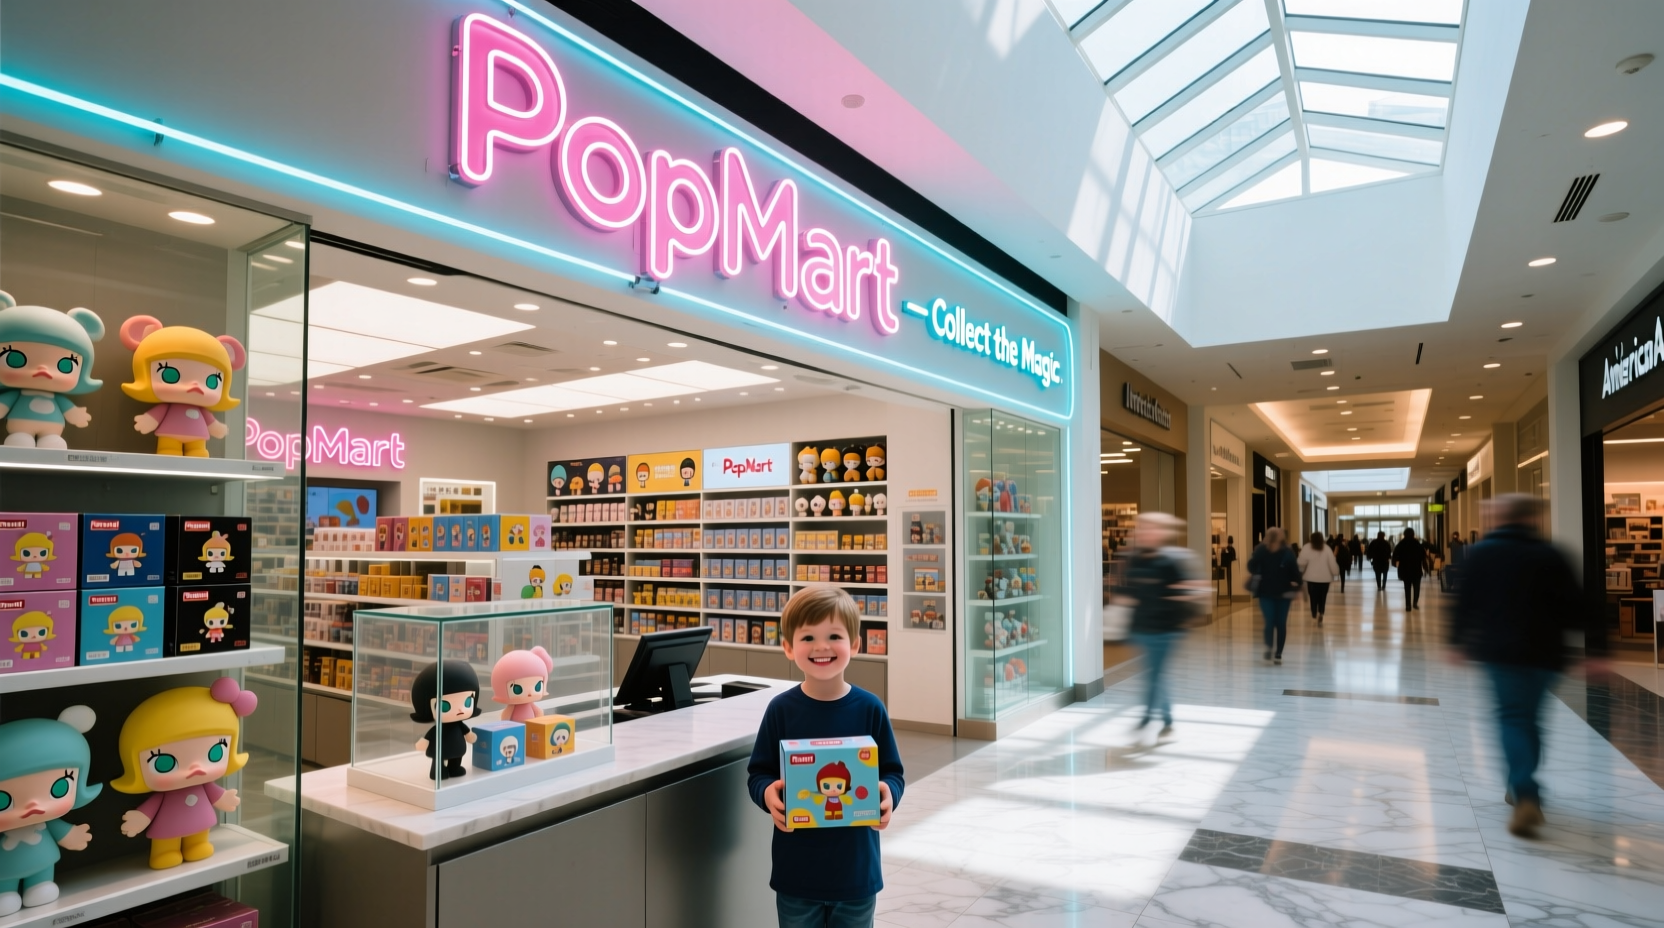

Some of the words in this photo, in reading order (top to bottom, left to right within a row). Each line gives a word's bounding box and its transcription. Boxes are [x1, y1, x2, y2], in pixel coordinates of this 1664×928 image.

[453, 12, 900, 336] PopMart
[931, 297, 992, 356] Collect
[993, 325, 1019, 367] the
